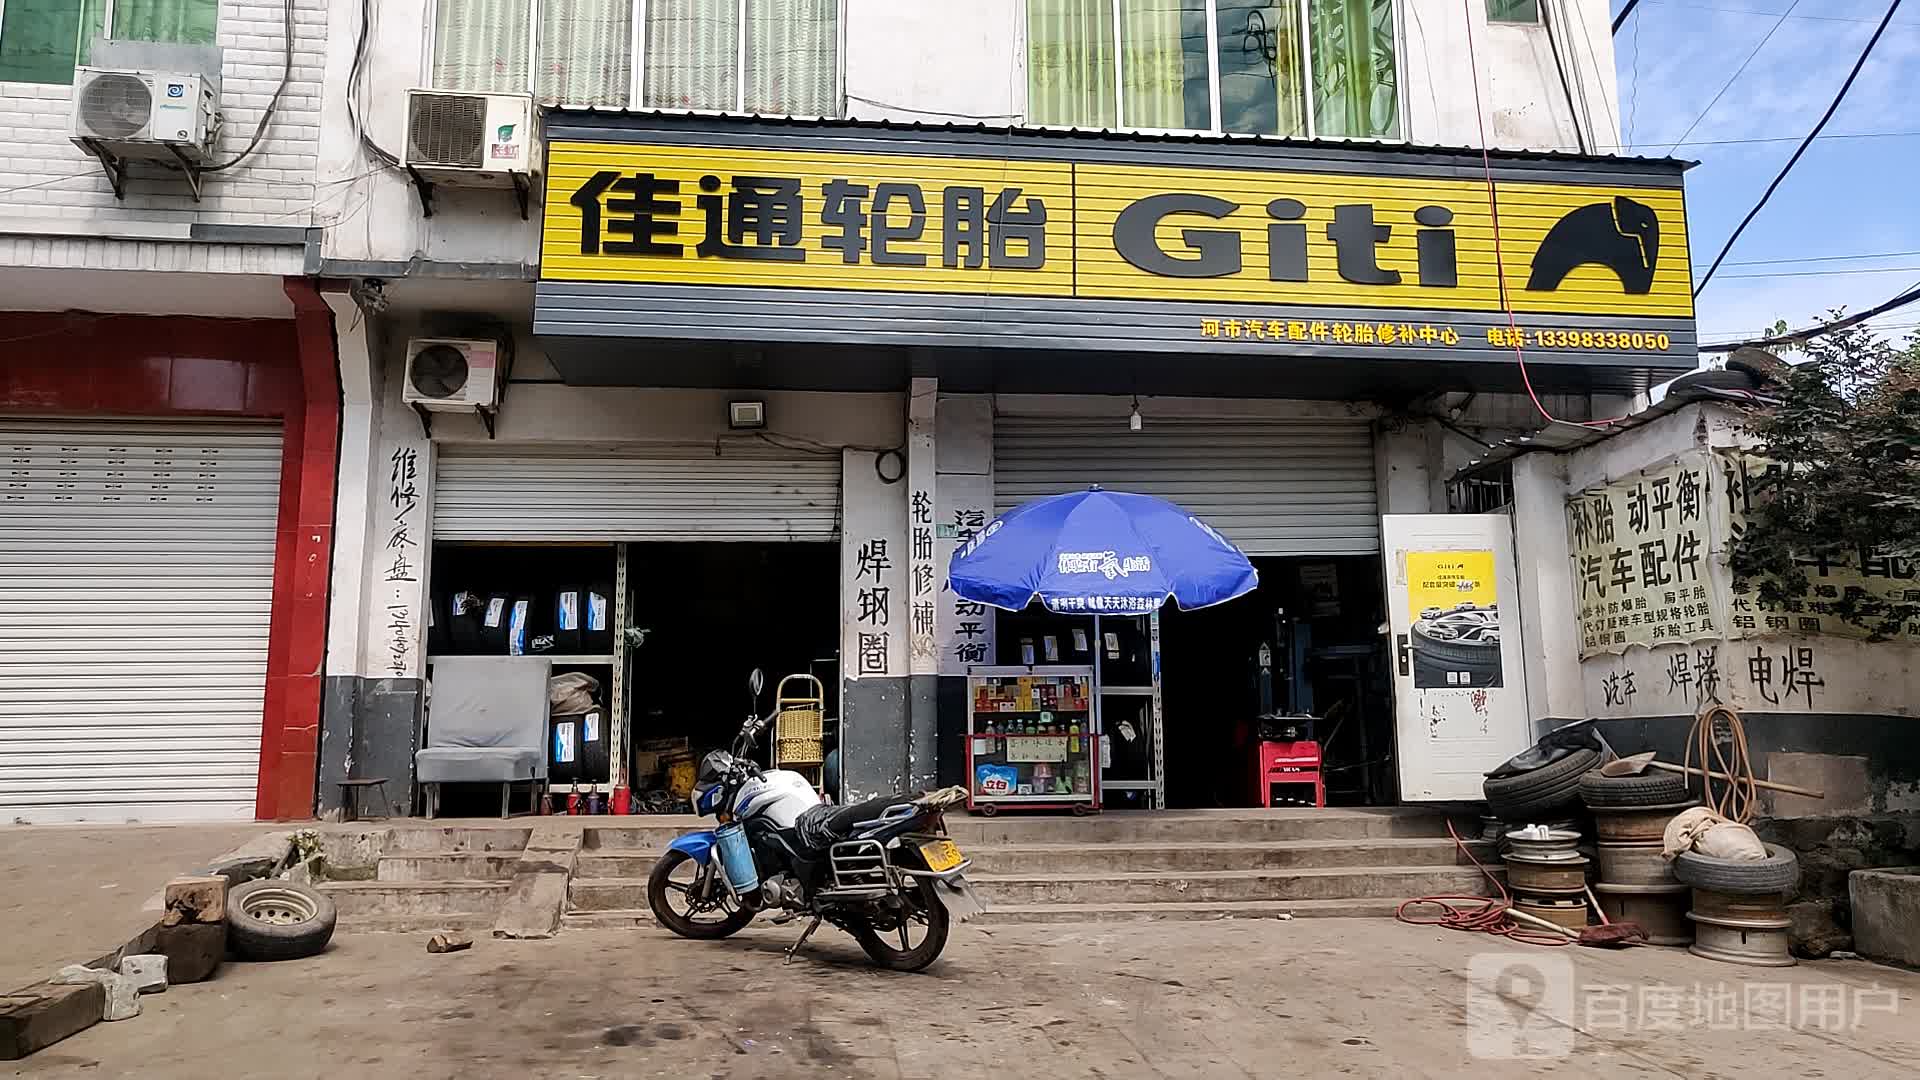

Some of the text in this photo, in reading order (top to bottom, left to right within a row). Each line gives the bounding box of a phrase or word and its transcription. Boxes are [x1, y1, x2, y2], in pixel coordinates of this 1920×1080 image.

[570, 171, 1048, 270] 佳通轮胎
[1113, 193, 1457, 288] Giti
[1200, 318, 1460, 346] 河市汽车配件轮胎修补中心
[1572, 469, 1700, 550] 补胎 动平衡
[1580, 530, 1702, 601] 汽车配件
[1664, 586, 1707, 604] 扁平胎
[855, 539, 892, 676] 焊钢圈
[1653, 620, 1714, 639] 拆胎工具
[1666, 646, 1723, 706] 焊接
[1748, 644, 1825, 710] 电焊
